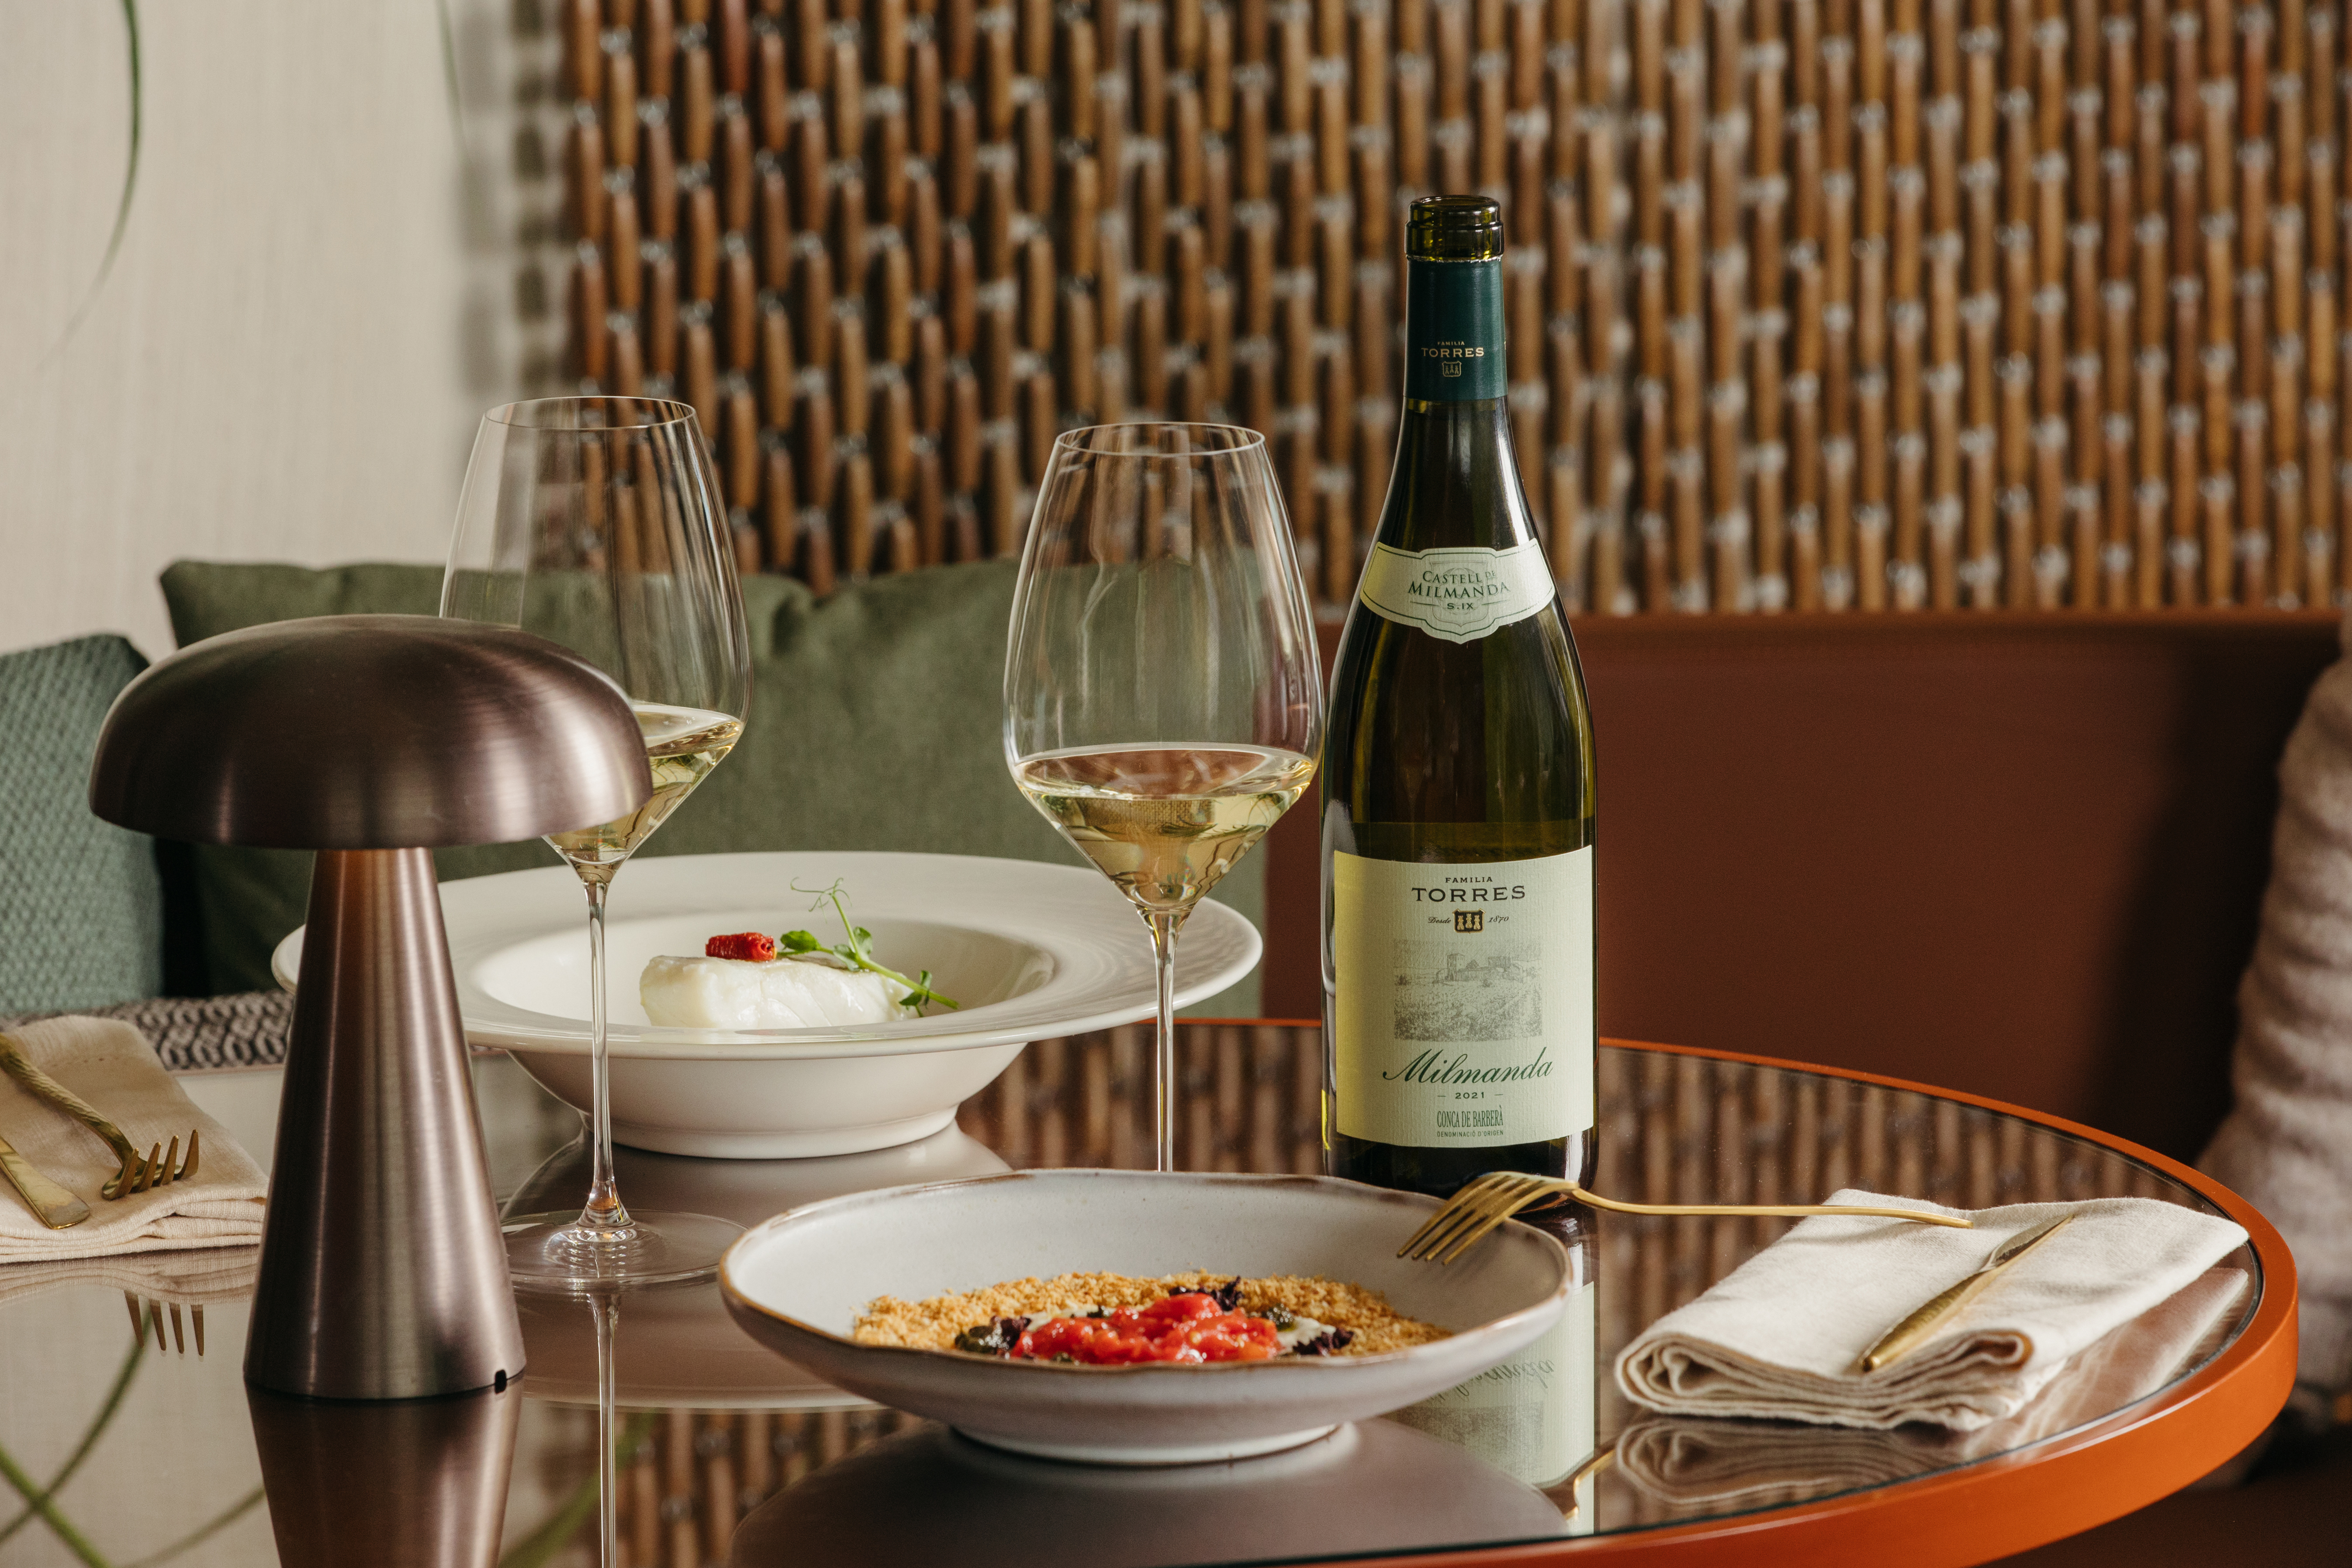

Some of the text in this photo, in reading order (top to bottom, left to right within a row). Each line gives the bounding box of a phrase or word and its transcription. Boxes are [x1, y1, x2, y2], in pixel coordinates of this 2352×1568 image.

[1421, 347, 1484, 357] TORRES
[1423, 571, 1483, 584] CASTELL
[1408, 581, 1511, 598] MILMANDA
[1411, 885, 1525, 902] TORRES
[1487, 915, 1509, 924] 1870
[1382, 1046, 1554, 1084] Milmanda
[1437, 1105, 1504, 1128] CONCA DE BARBERÀ
